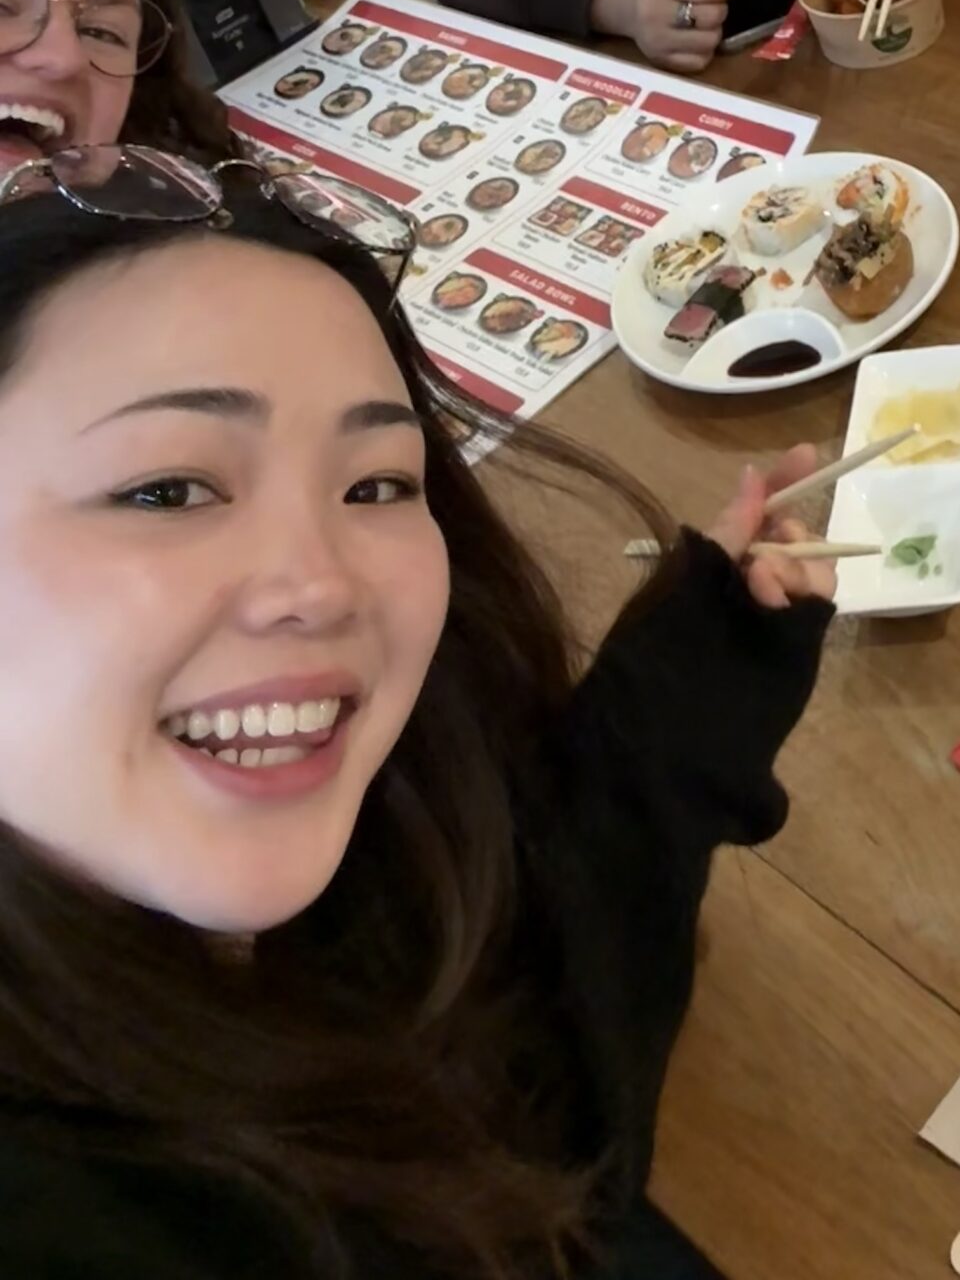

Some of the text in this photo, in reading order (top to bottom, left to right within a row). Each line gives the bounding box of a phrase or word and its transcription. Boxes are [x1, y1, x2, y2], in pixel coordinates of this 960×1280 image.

[698, 113, 734, 130] CURRY
[620, 201, 657, 221] BENTO
[509, 269, 577, 306] SALAD BOWL
